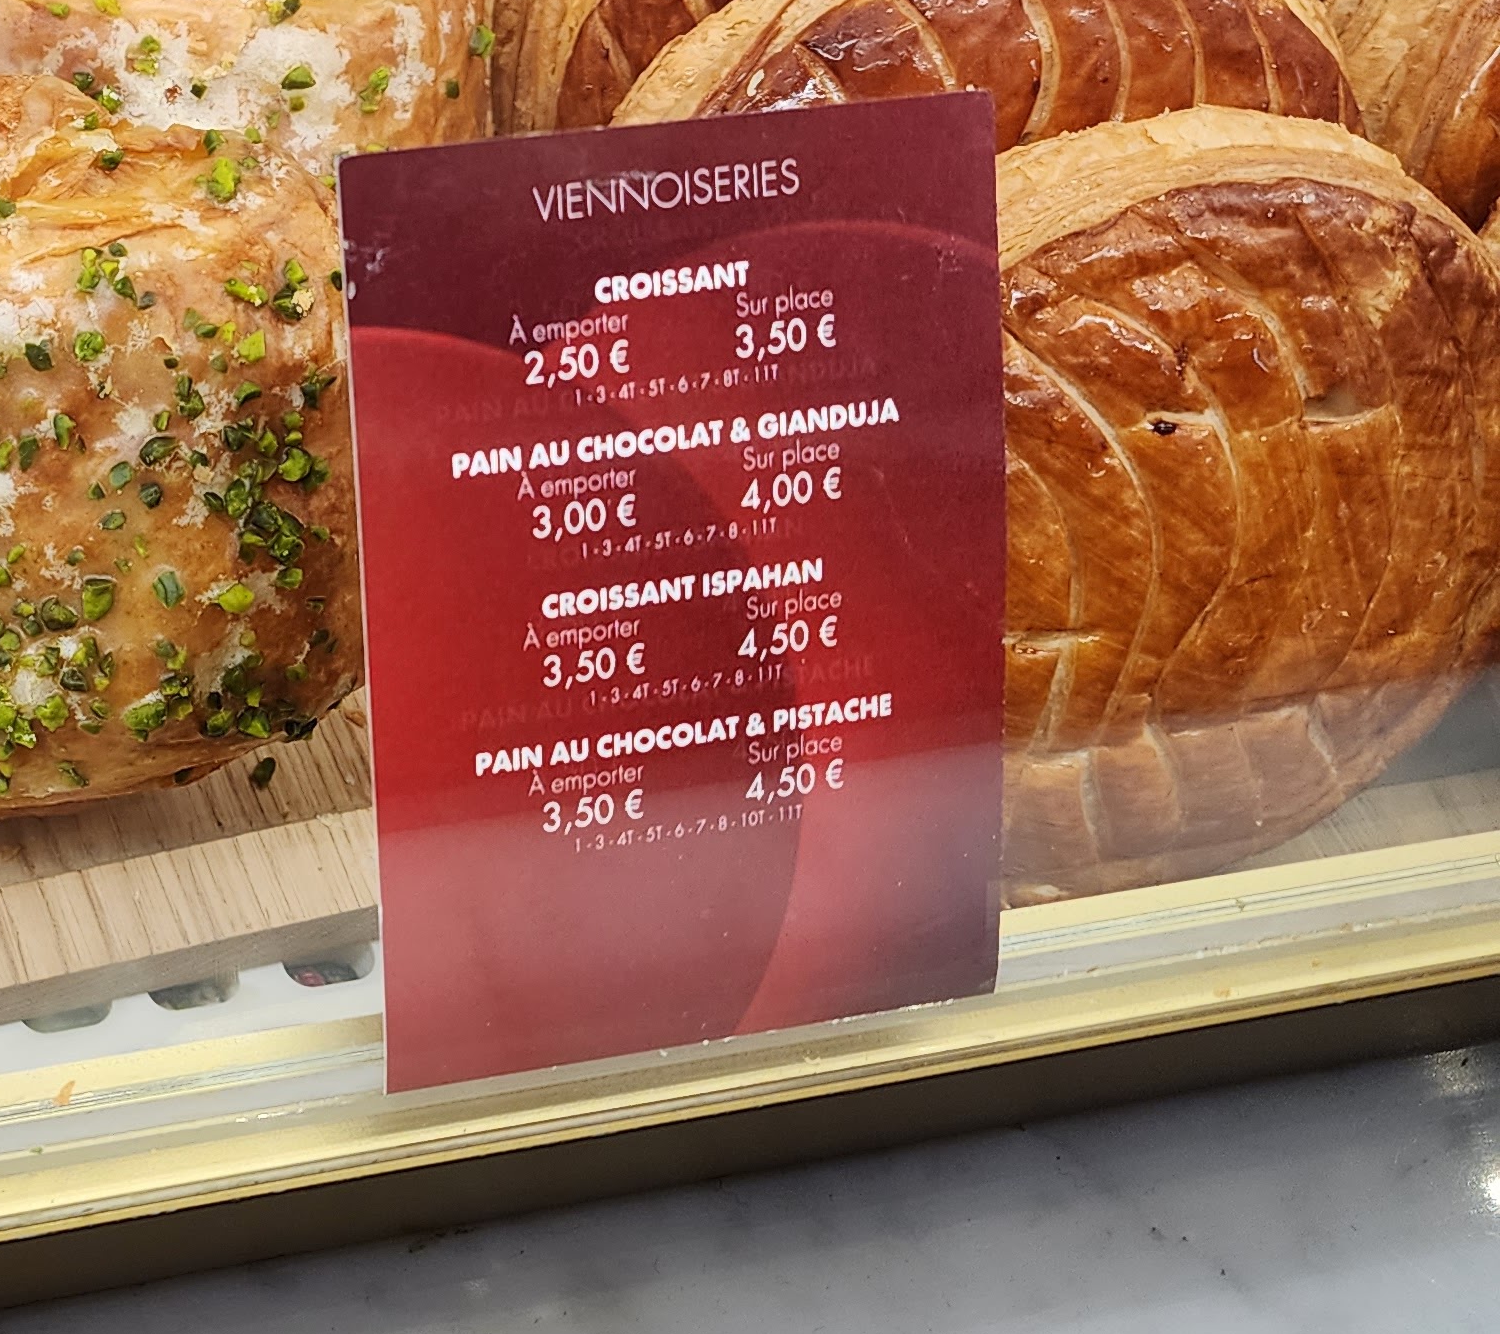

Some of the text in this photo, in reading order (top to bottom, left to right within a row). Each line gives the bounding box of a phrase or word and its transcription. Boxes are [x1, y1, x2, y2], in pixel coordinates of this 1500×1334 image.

[531, 157, 800, 223] VIENNOISERIES
[594, 260, 750, 304] CROISSANT
[736, 284, 834, 320] Sur place
[509, 313, 629, 346] À emporter
[735, 313, 837, 363] 3,50 €
[523, 338, 631, 389] 2,50 €
[452, 397, 900, 480] PAIN AU CHOCOLAT & GIANDUJA
[742, 438, 841, 473] Sur place
[517, 468, 637, 501] À emporter
[740, 466, 843, 515] 4,00 €
[532, 493, 637, 543] 3,00 €
[541, 556, 823, 620] CROISSANT ISPAHAN
[745, 588, 843, 622] Sur place
[523, 618, 641, 652] À emporter
[737, 615, 839, 664] 4,50 €
[542, 642, 646, 691] 3,50 €
[475, 692, 893, 777] PAIN AU CHOCOLAT & PISTACHE
[747, 733, 843, 766] Sur place
[528, 764, 645, 797] À emporter
[745, 757, 845, 805] 4,50 €
[542, 788, 645, 836] 3,50 €
